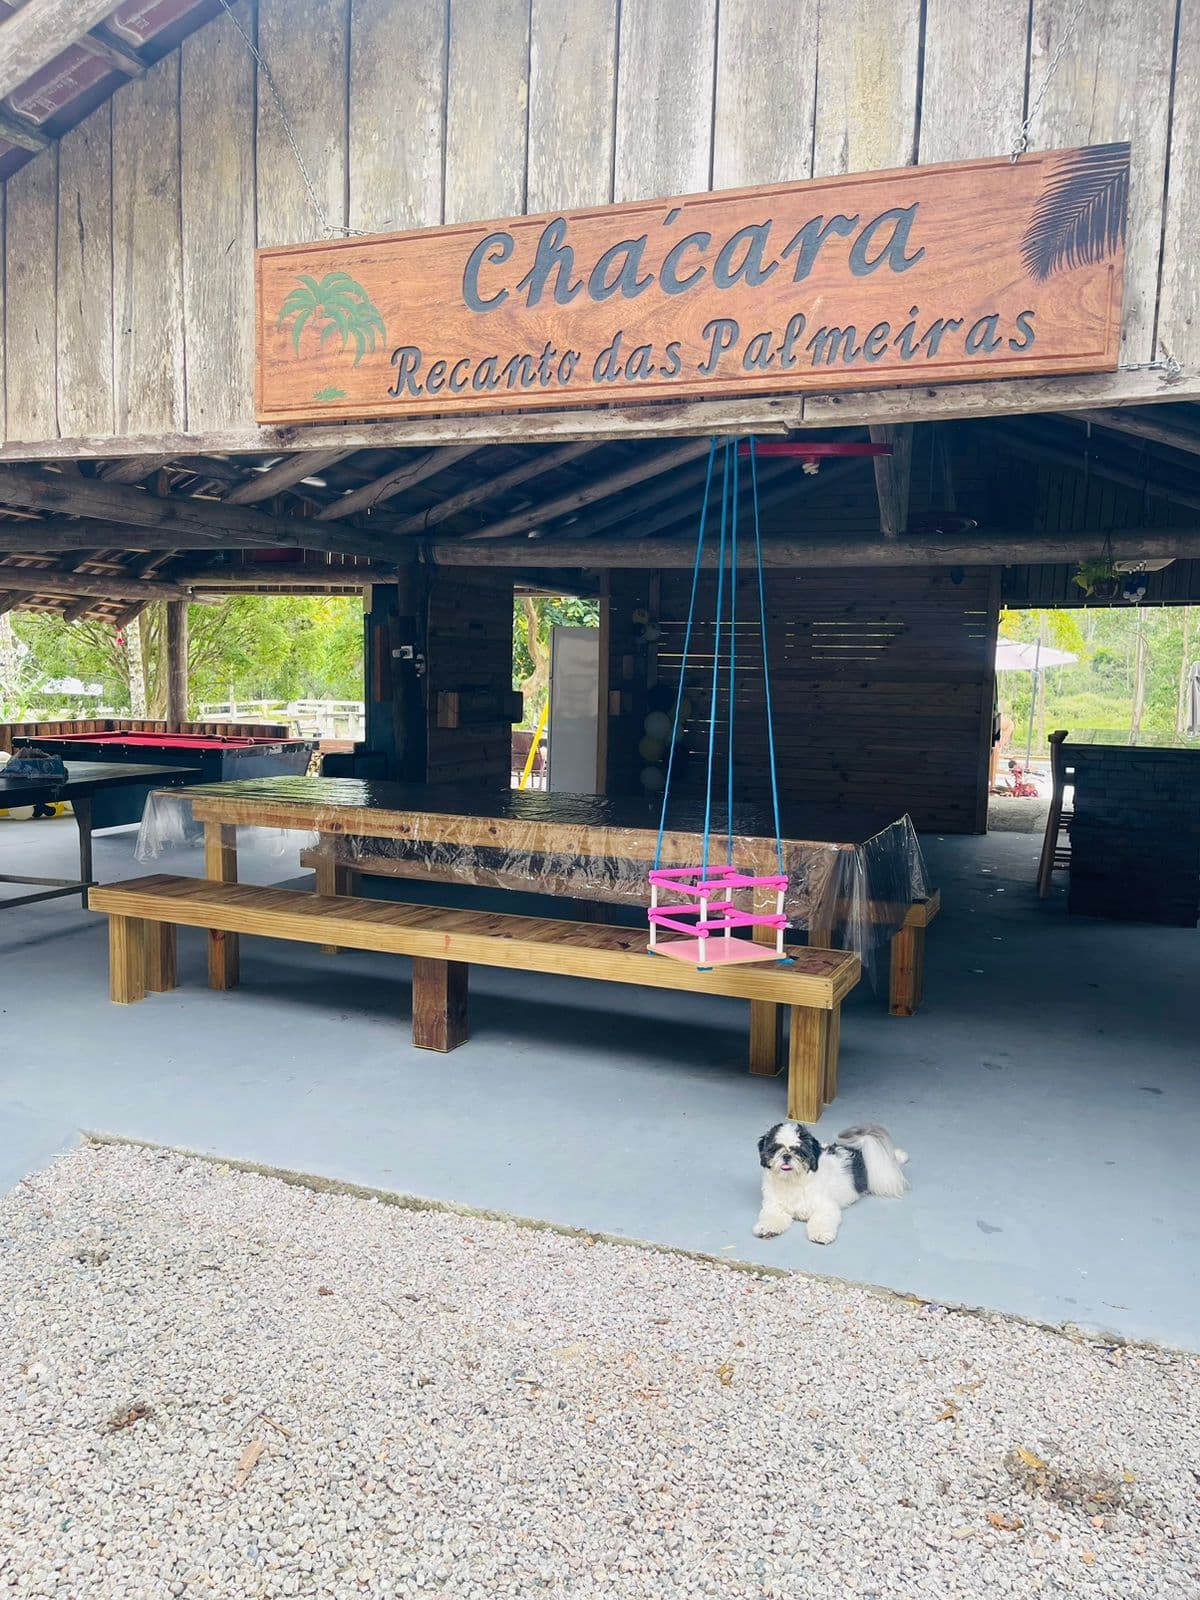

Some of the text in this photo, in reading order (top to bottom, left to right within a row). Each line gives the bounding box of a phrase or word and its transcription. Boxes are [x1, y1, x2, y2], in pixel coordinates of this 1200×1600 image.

[463, 201, 925, 312] Chácara
[388, 306, 1036, 398] Recanto das Palmeiras
